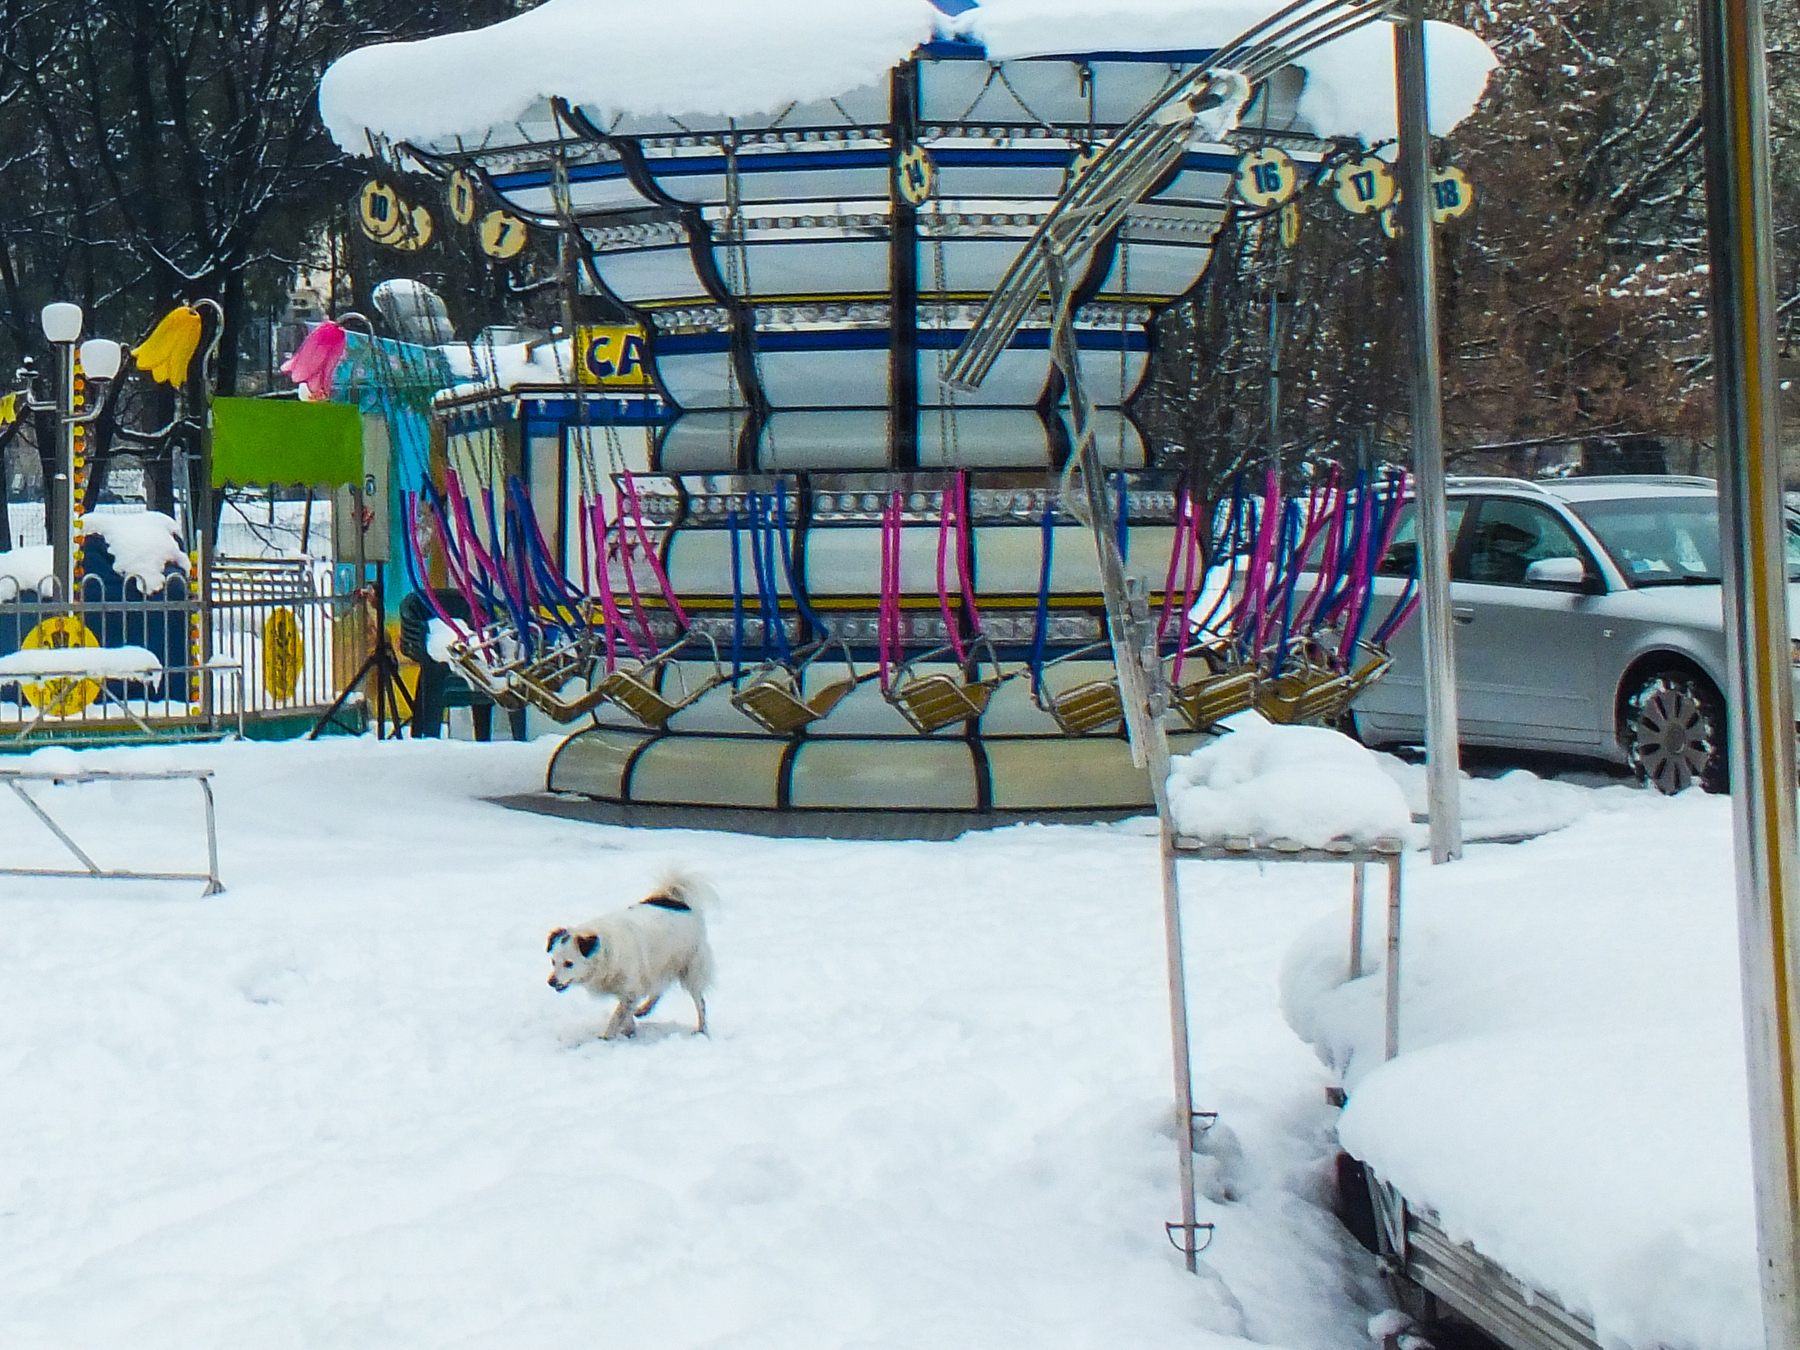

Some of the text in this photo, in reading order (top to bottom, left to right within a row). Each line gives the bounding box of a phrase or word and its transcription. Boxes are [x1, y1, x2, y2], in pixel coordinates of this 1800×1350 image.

[904, 159, 926, 191] 14
[1249, 161, 1281, 194] 16
[1349, 170, 1376, 202] 17
[1432, 178, 1460, 210] 18
